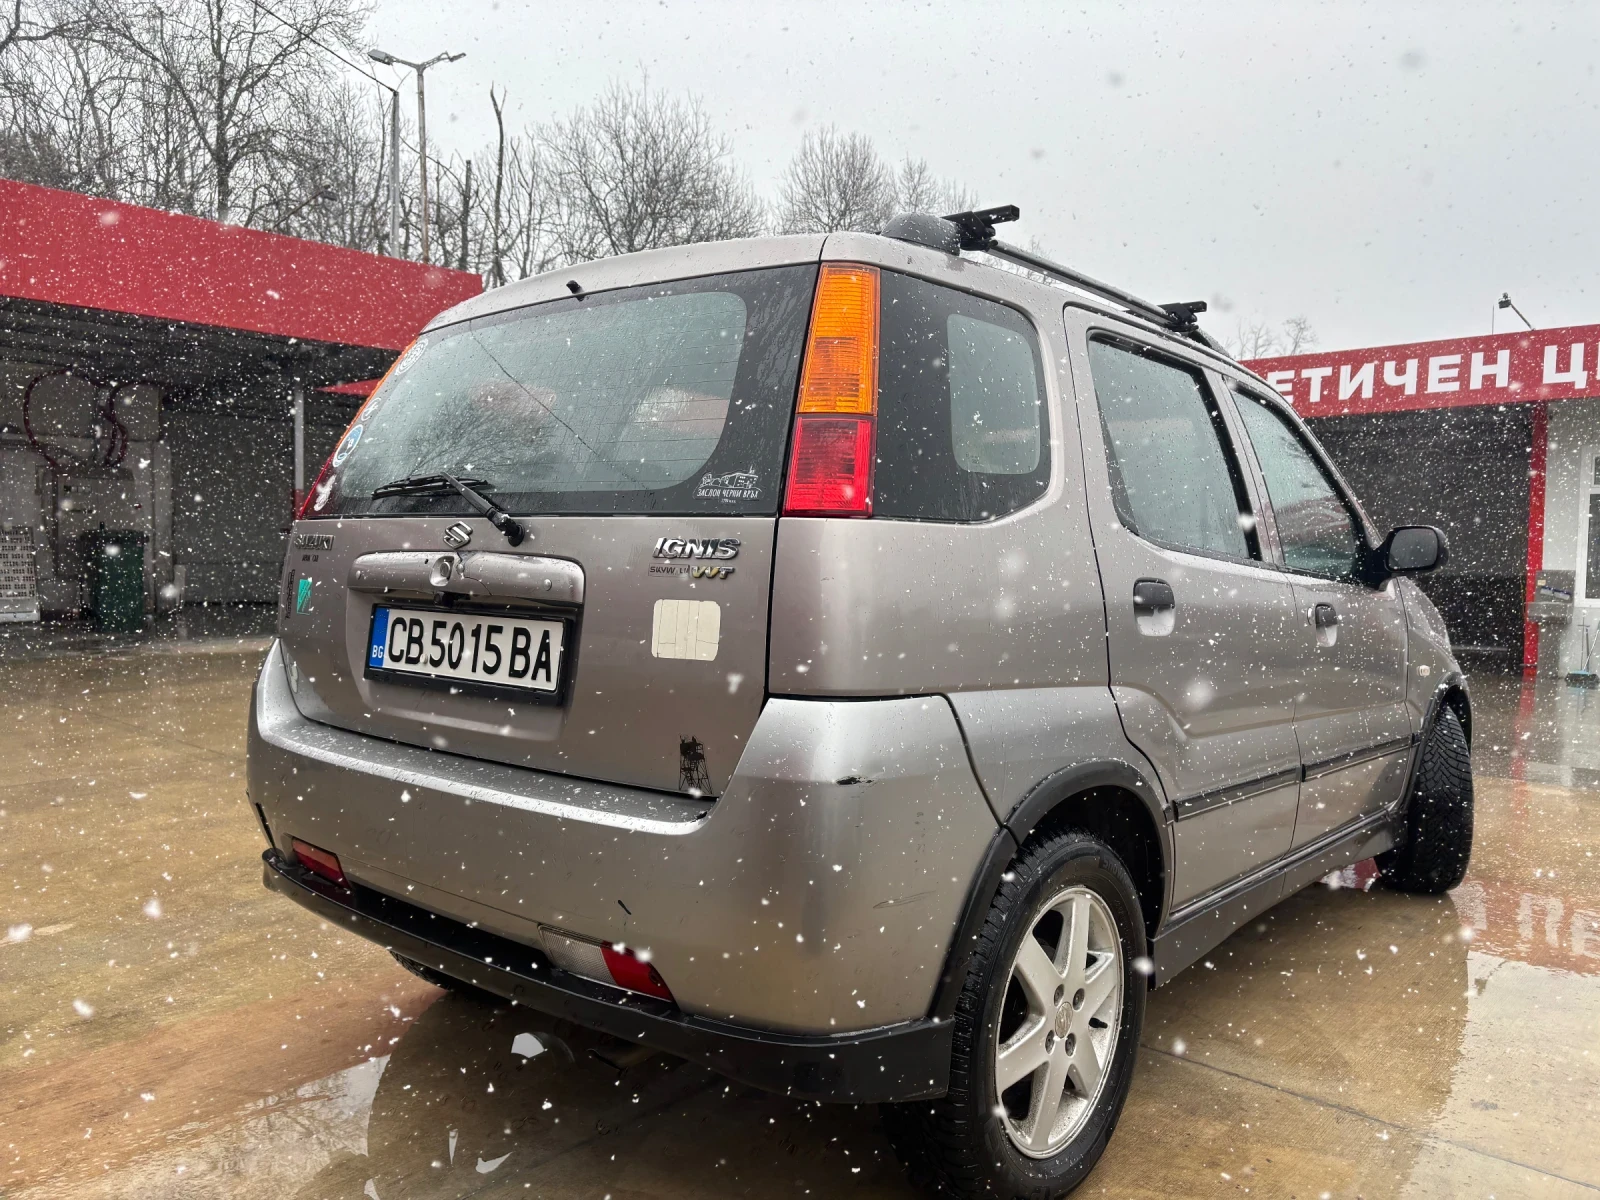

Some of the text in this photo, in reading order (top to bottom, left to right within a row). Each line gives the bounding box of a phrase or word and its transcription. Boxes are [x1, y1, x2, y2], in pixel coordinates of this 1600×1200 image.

[1542, 342, 1600, 389] Ц
[652, 536, 741, 560] IGNIS
[372, 644, 384, 659] BG
